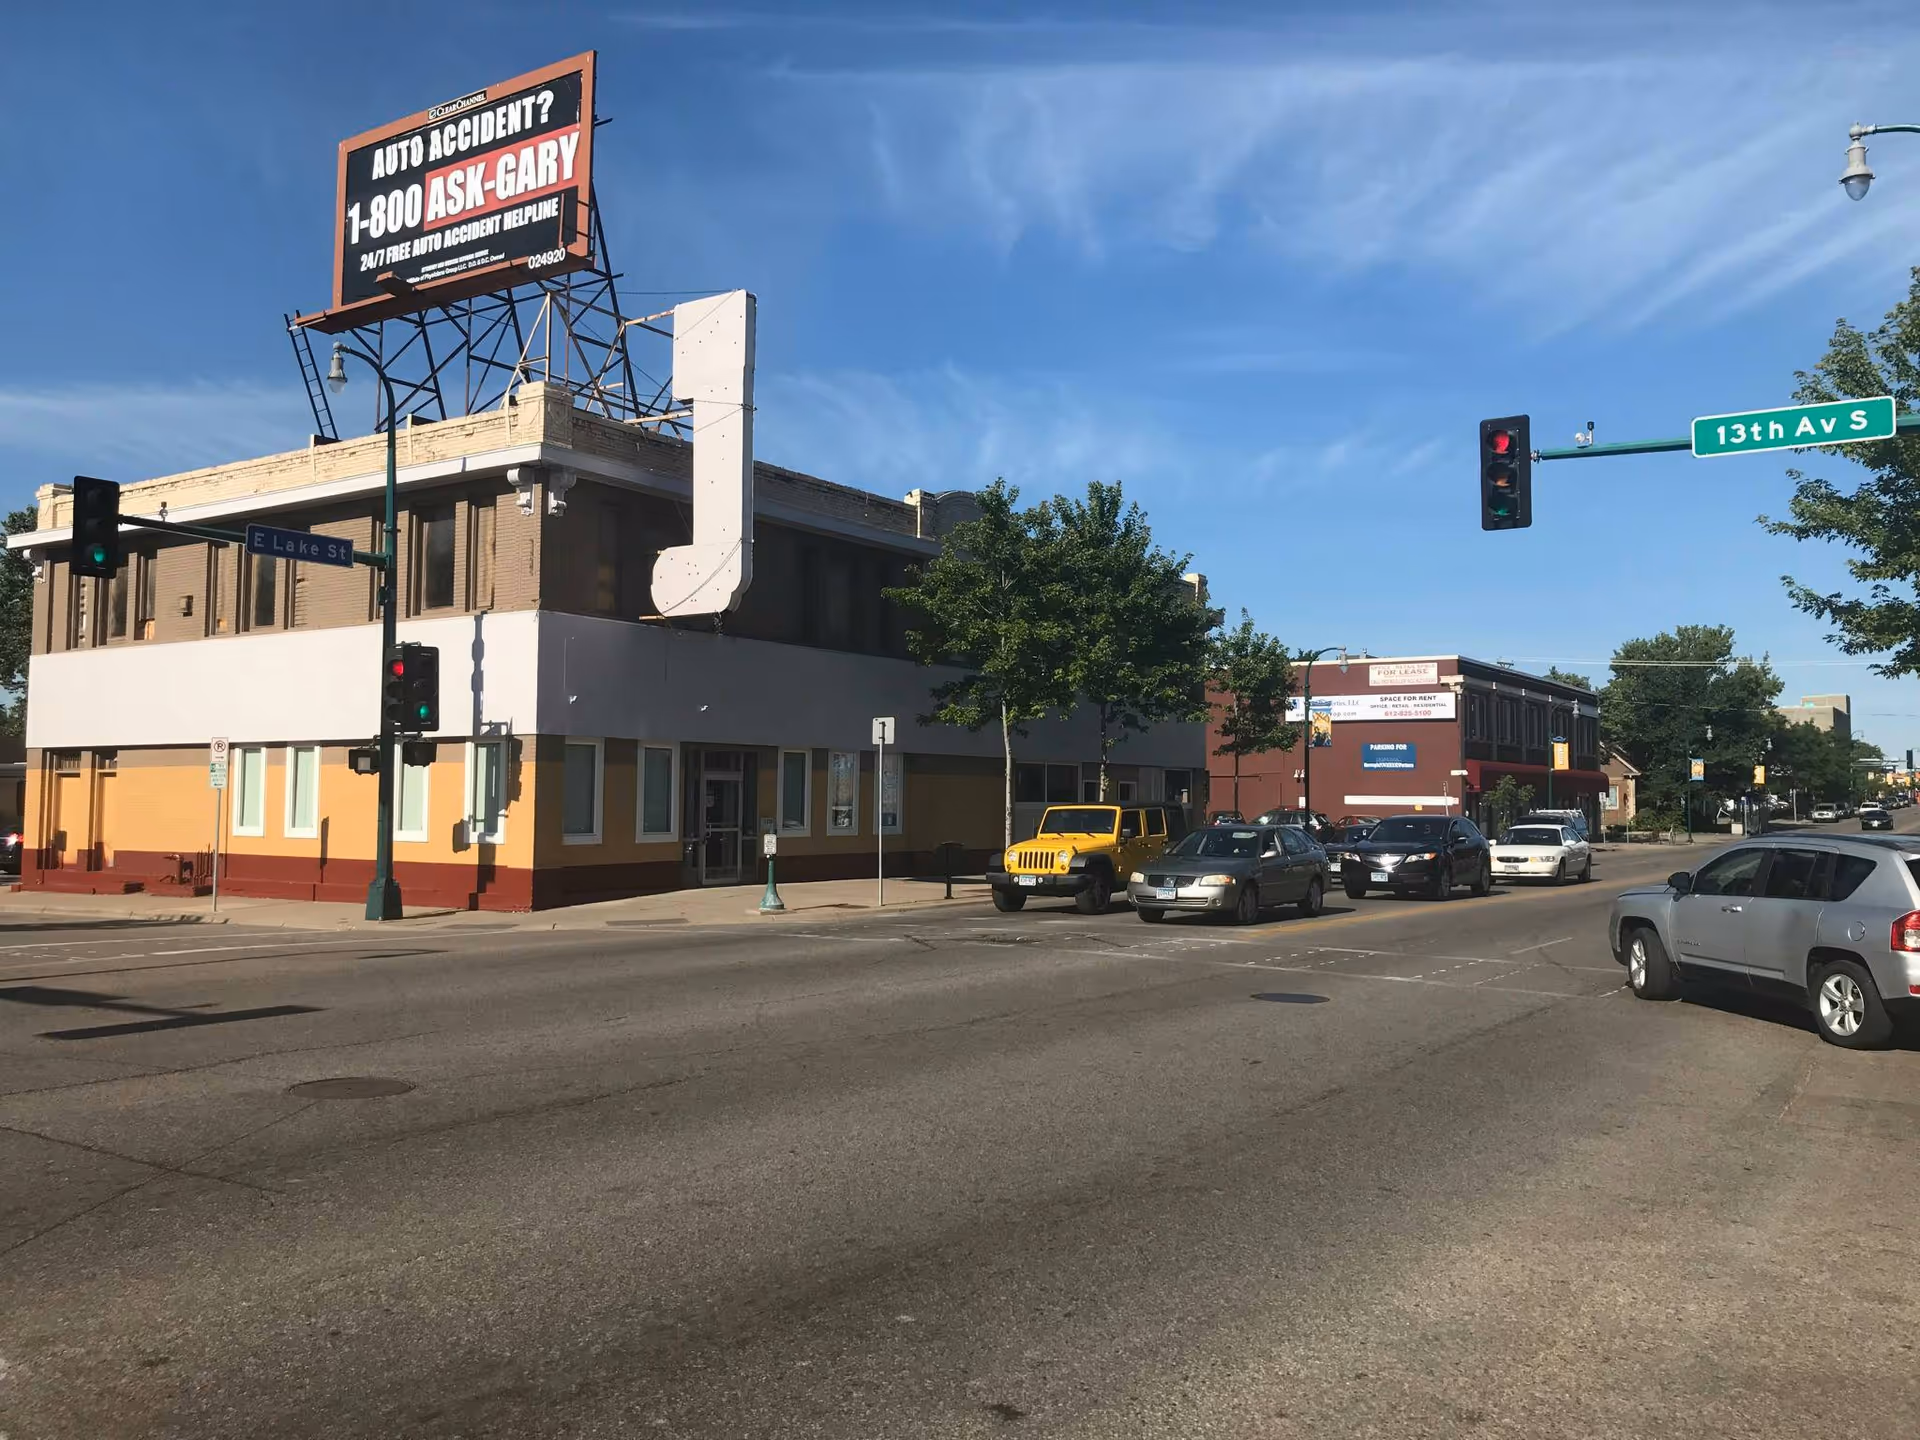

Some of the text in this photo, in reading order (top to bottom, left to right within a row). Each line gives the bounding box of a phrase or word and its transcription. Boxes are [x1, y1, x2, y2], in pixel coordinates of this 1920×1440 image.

[372, 90, 554, 180] AUTO ACCIDENT?
[347, 131, 580, 245] 1-800 ASK-GARY
[360, 248, 386, 272] 24/7
[386, 239, 411, 264] FREE
[412, 233, 441, 257] AUTO
[443, 215, 501, 249] ACCIDENT
[503, 197, 559, 230] HELPLINE
[528, 247, 566, 270] 024920
[1716, 409, 1869, 446] 13th Av S
[254, 532, 347, 560] E Lake St
